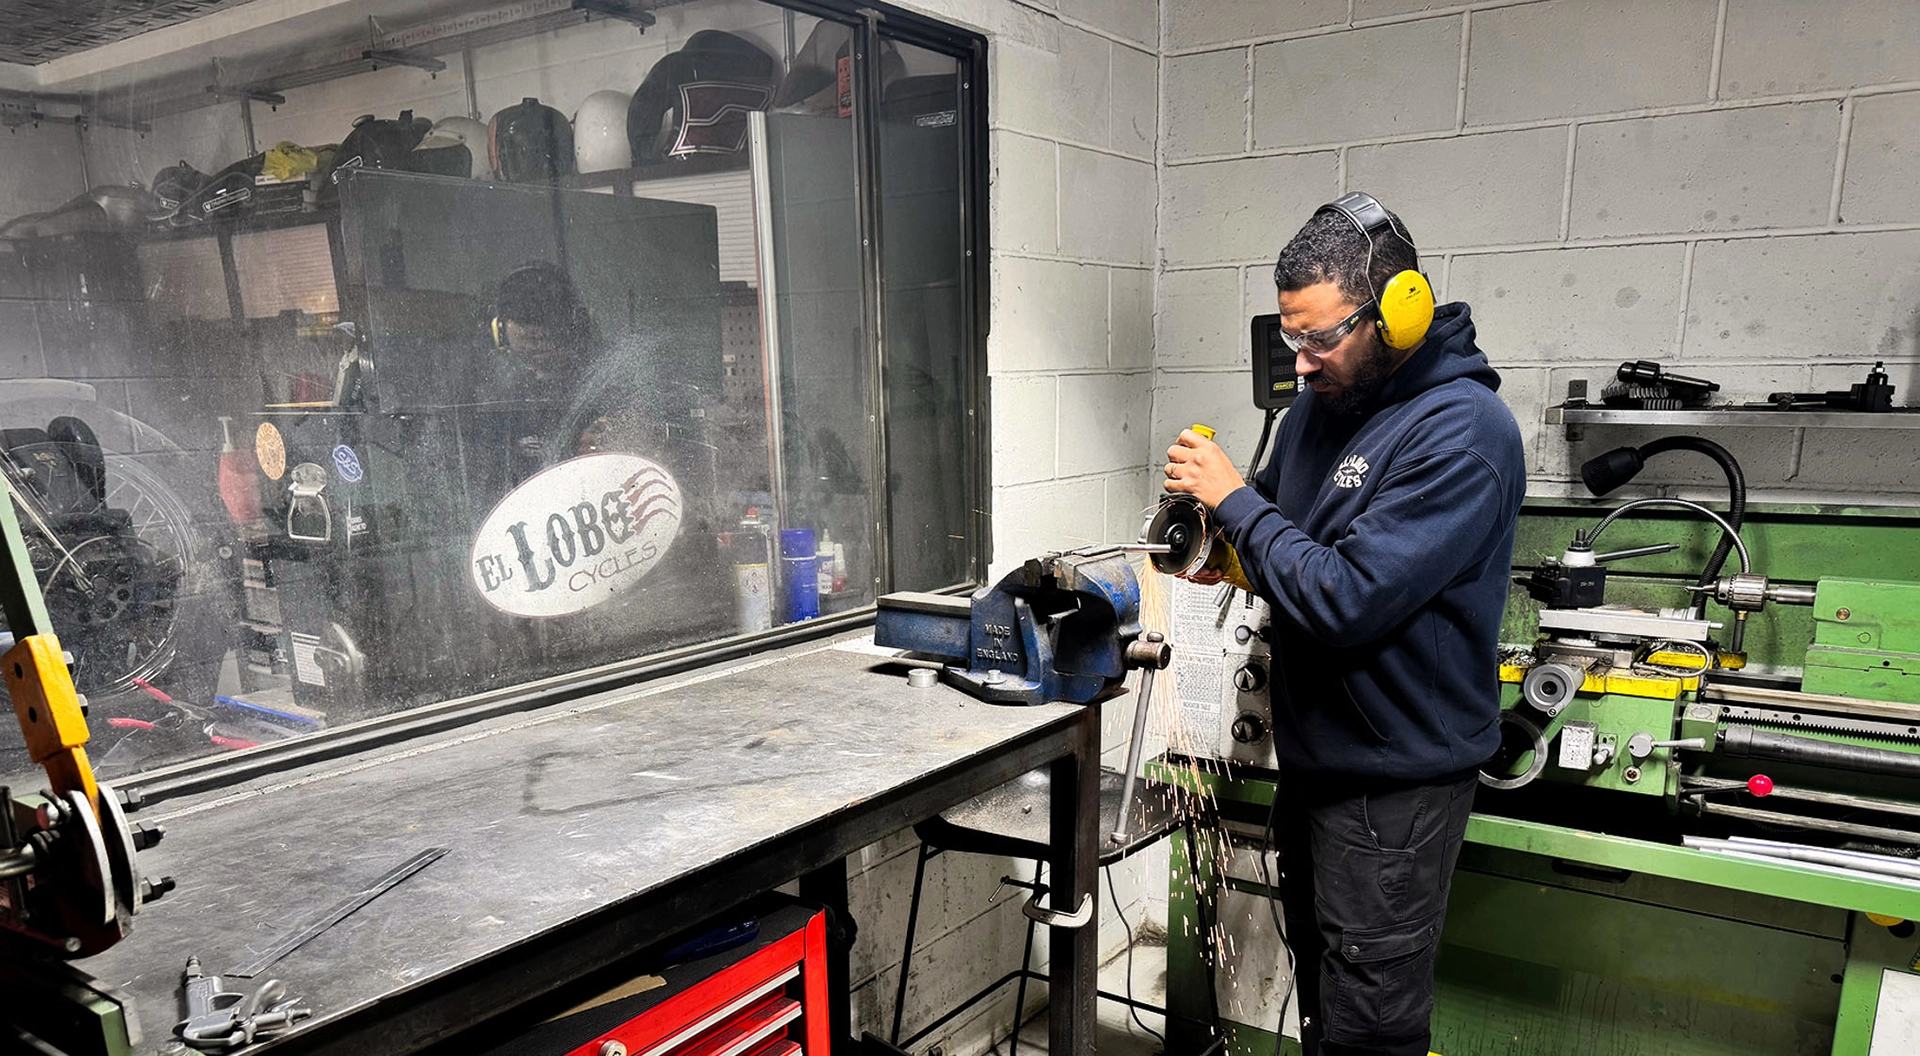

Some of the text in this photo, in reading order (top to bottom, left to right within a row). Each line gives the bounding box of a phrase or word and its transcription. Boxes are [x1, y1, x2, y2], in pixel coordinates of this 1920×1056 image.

[476, 489, 636, 593] EL LOBO
[568, 540, 658, 592] CYCLES
[984, 623, 1011, 636] MADE
[993, 637, 1003, 648] IN
[976, 647, 1019, 662] ENGLAND
